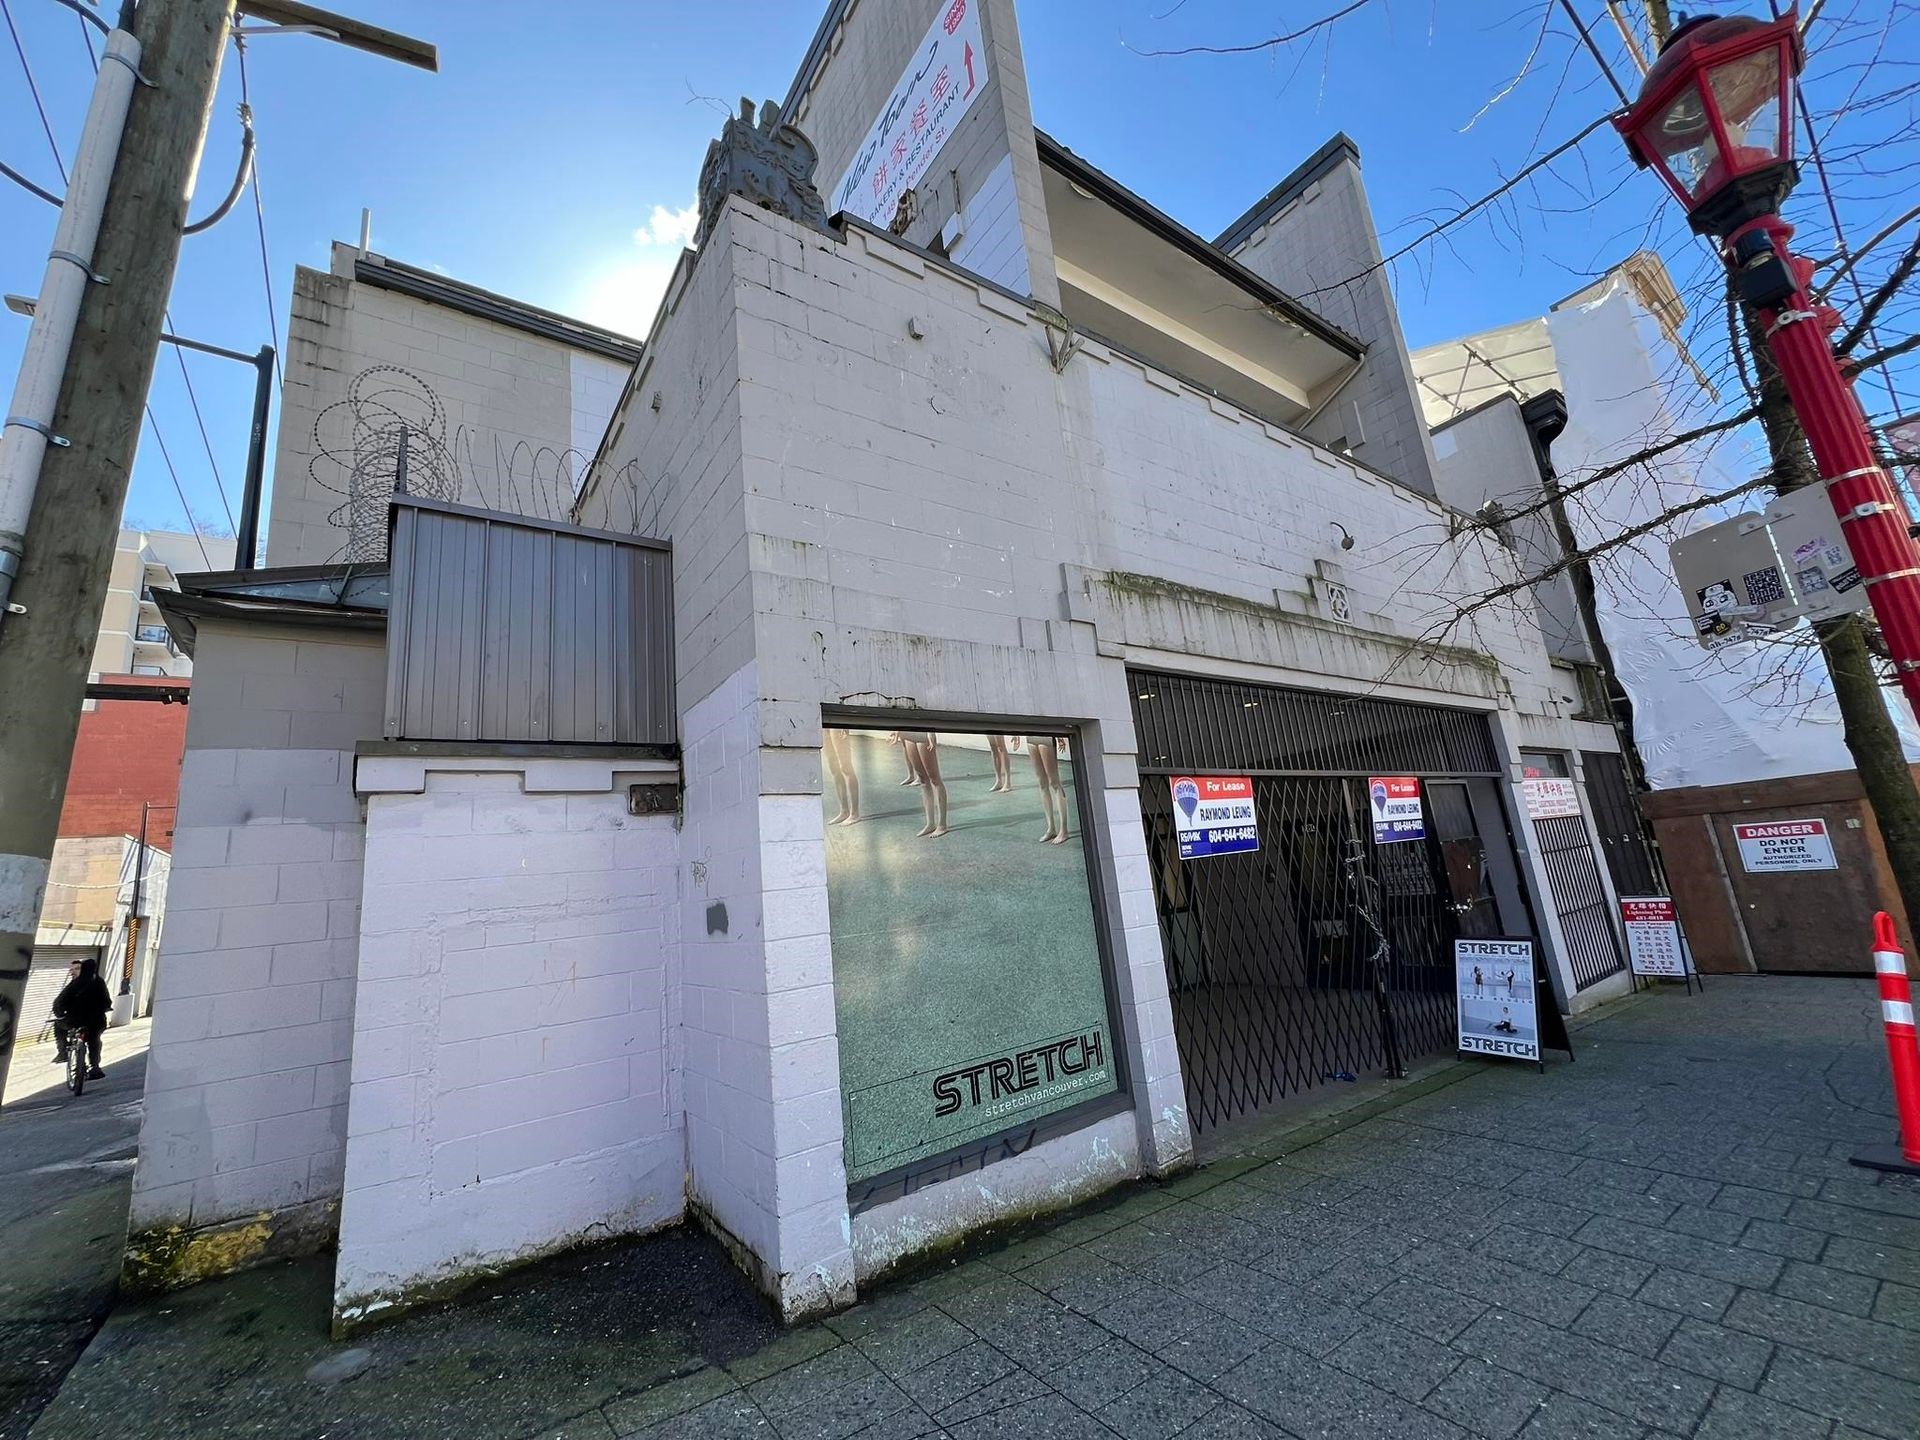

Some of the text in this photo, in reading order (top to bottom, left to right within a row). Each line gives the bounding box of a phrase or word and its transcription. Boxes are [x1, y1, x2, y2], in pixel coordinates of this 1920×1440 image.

[878, 40, 939, 148] Town
[869, 177, 898, 222] BAKERY
[905, 81, 961, 170] RESTAURANT
[1206, 781, 1246, 792] For Lease
[1391, 783, 1401, 793] For
[1401, 784, 1415, 792] Lease
[1200, 805, 1252, 822] RAYMOND LEUNG
[1745, 824, 1815, 838] DANGER
[1759, 837, 1806, 847] DO NOT
[1764, 845, 1807, 855] ENTER
[1458, 942, 1530, 956] STRETCH
[1461, 1035, 1537, 1057] STRETCH
[932, 1031, 1104, 1118] STRETCH
[984, 1069, 1106, 1117] stretchvancouver.com
